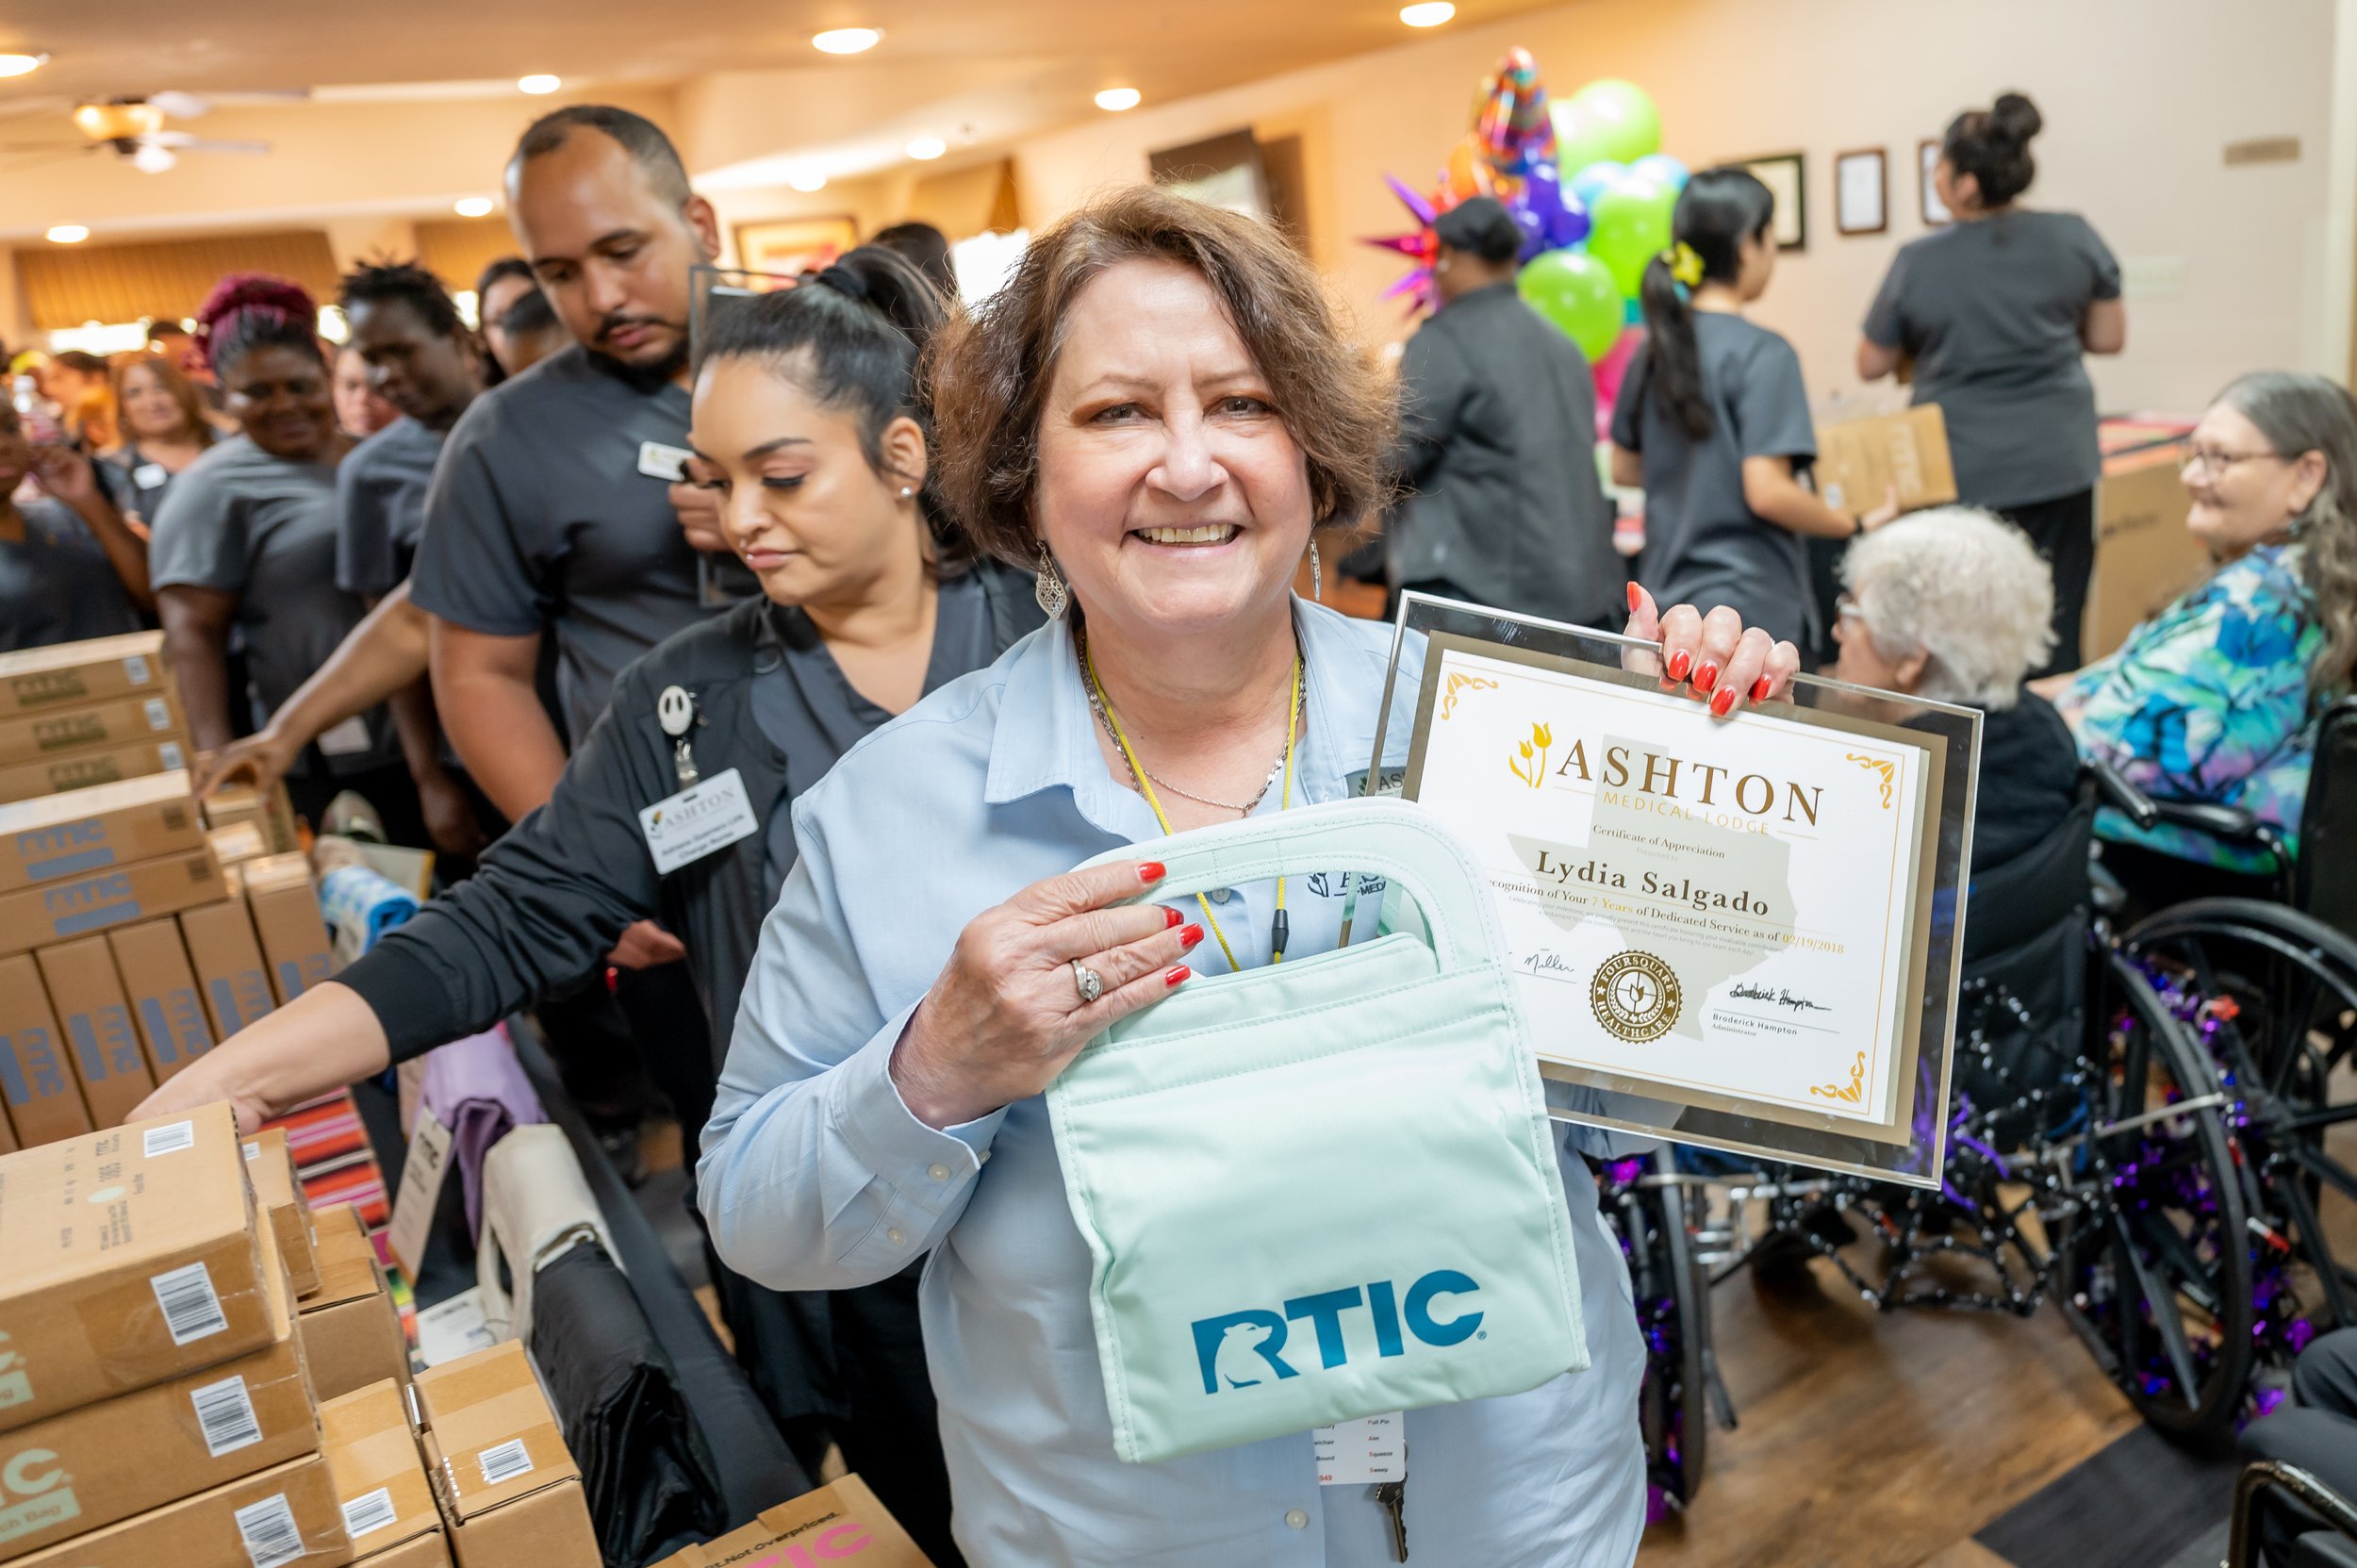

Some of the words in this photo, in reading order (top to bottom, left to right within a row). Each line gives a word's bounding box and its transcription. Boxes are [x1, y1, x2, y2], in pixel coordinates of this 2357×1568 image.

[1556, 738, 1824, 827] ASHTON
[1603, 791, 1693, 820] MEDICAL
[1705, 811, 1770, 835] LODGE
[1592, 824, 1646, 843] Certificate
[1649, 836, 1661, 847] of
[1661, 837, 1725, 858] Appreciation
[1536, 850, 1627, 889] Lydia
[1641, 871, 1769, 916] Salgado
[1489, 879, 1544, 898] cognition
[1547, 887, 1559, 899] of
[1560, 891, 1588, 904] Your
[1591, 897, 1598, 906] 7
[1601, 899, 1633, 913] Years
[1636, 905, 1648, 916] of
[1651, 908, 1706, 928] Dedicated
[1709, 919, 1750, 936] Service
[1753, 930, 1764, 938] as
[1767, 931, 1780, 941] of
[1781, 933, 1845, 954] 02/19/2018
[1601, 955, 1674, 993] FOURSQUARE
[1596, 999, 1671, 1038] HEALTHCARE
[1711, 1023, 1757, 1037] Administrator
[1712, 1013, 1755, 1028] Broderick
[1757, 1021, 1798, 1036] Hampton
